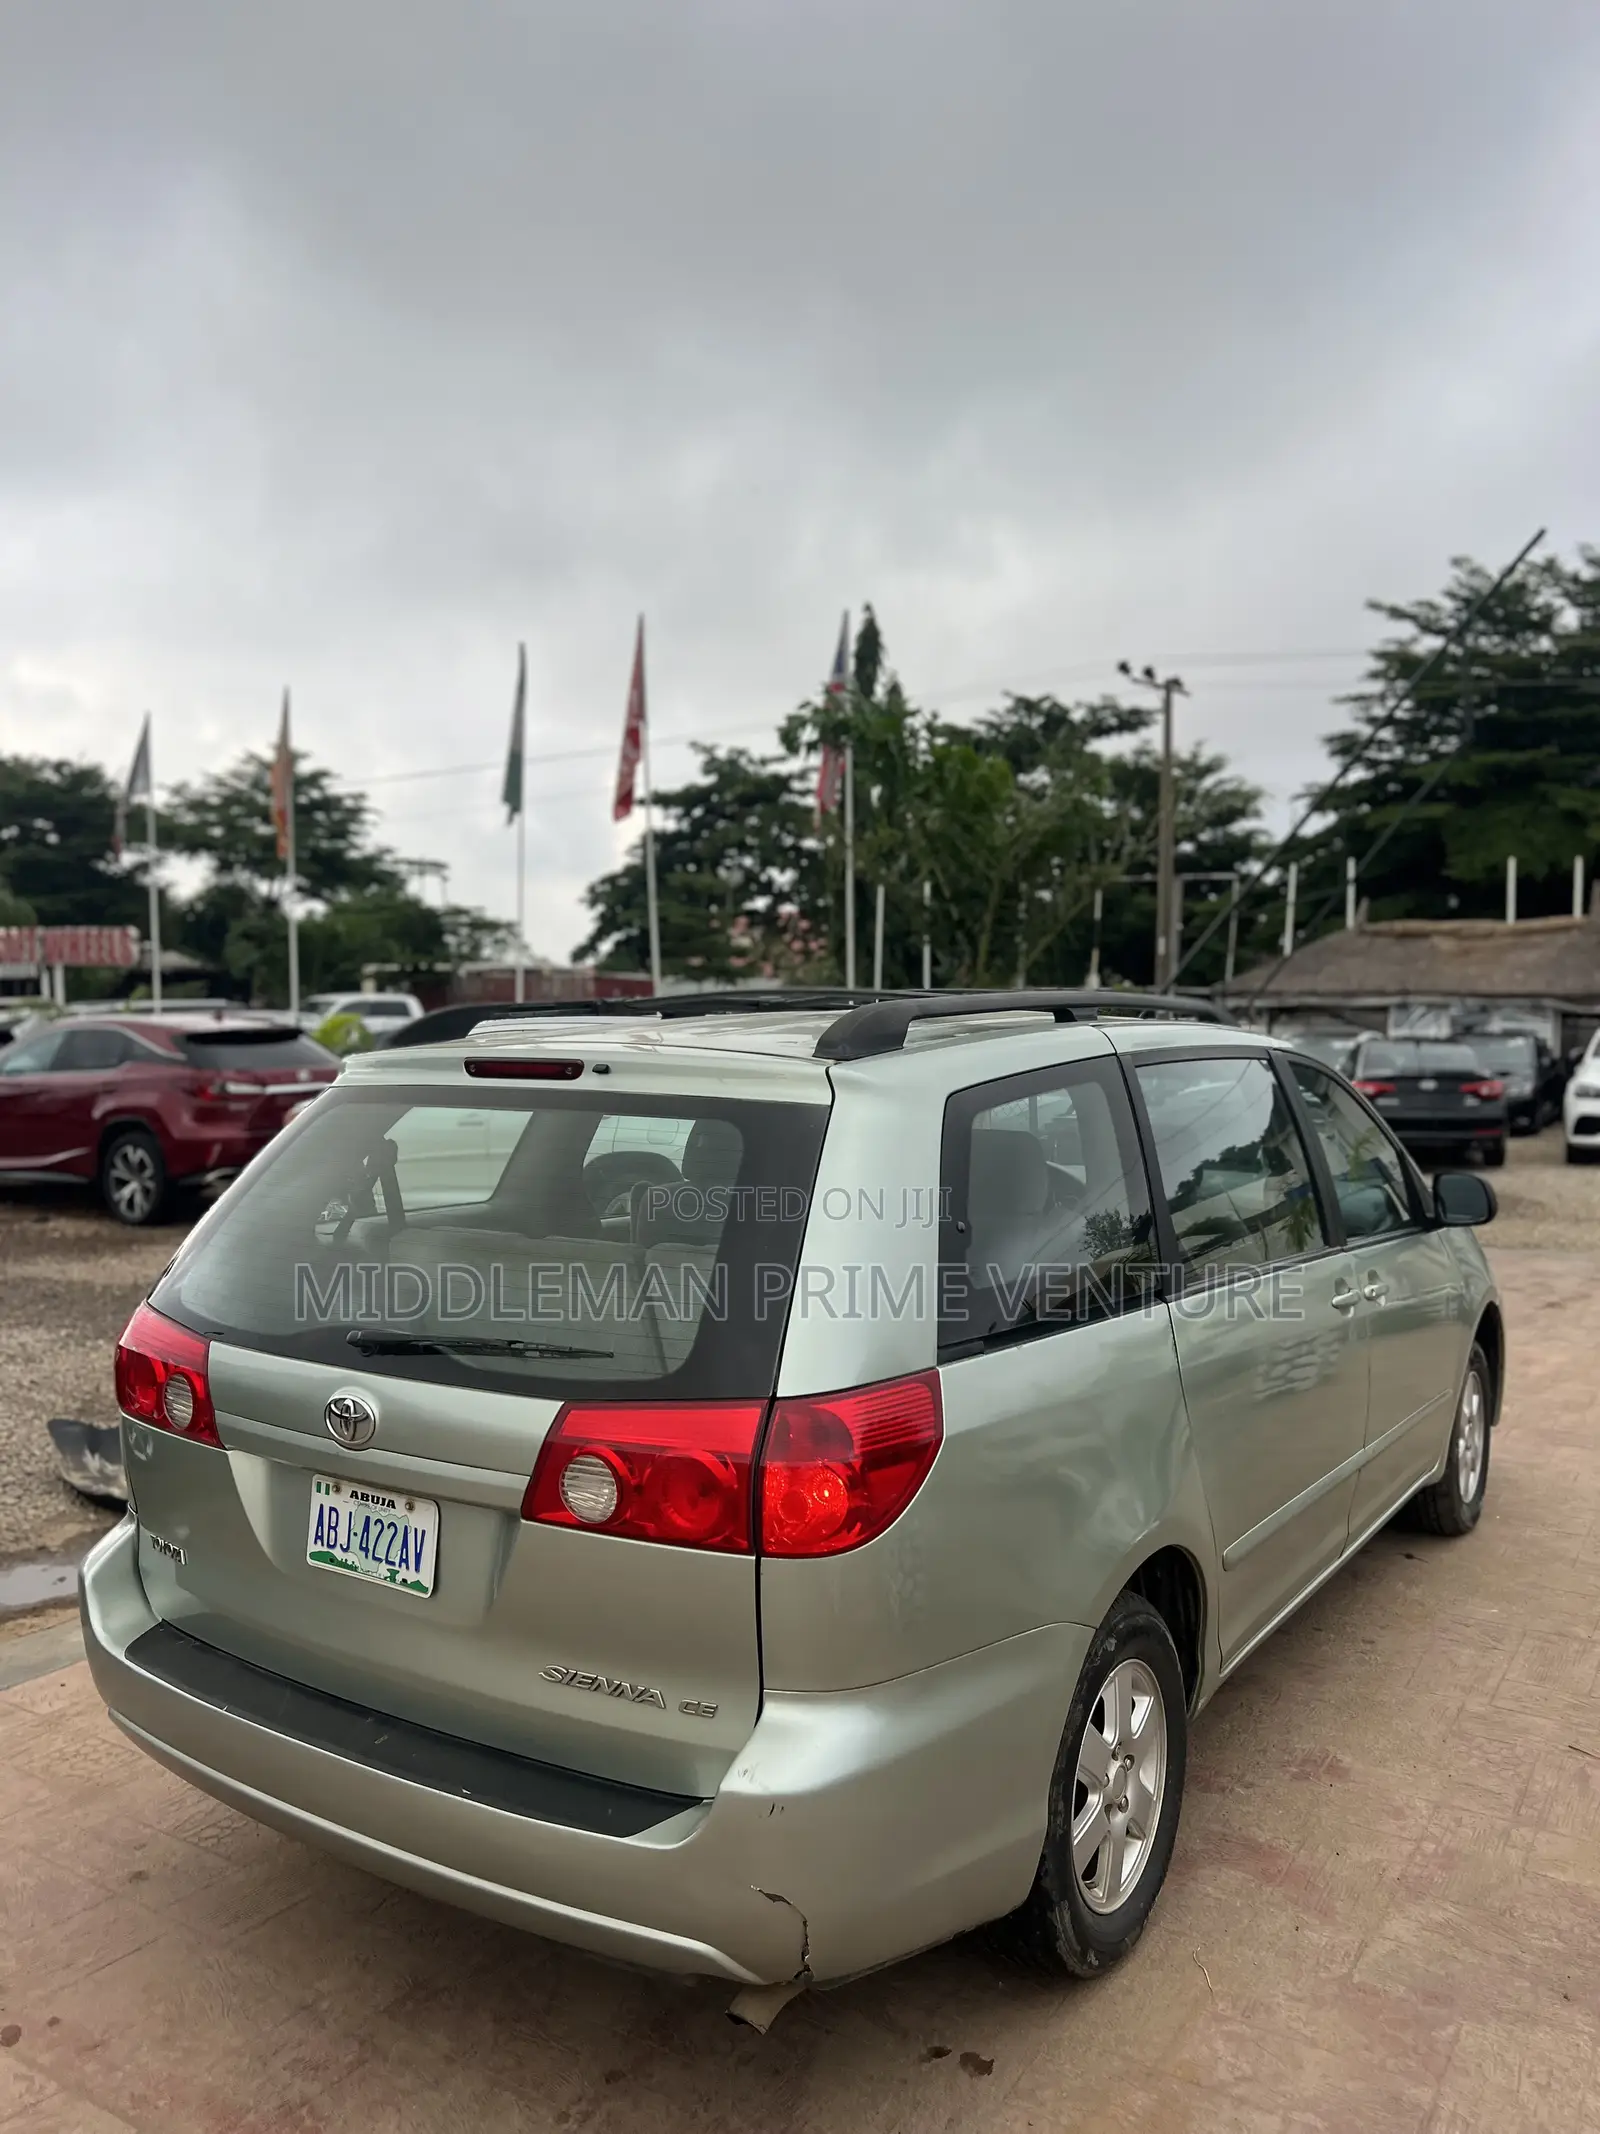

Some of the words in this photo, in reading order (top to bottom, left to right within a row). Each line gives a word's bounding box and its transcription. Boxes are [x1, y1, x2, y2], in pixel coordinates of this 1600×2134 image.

[349, 1489, 397, 1510] ABUJA
[538, 1663, 667, 1710] SIENNA
[677, 1697, 719, 1719] CE
